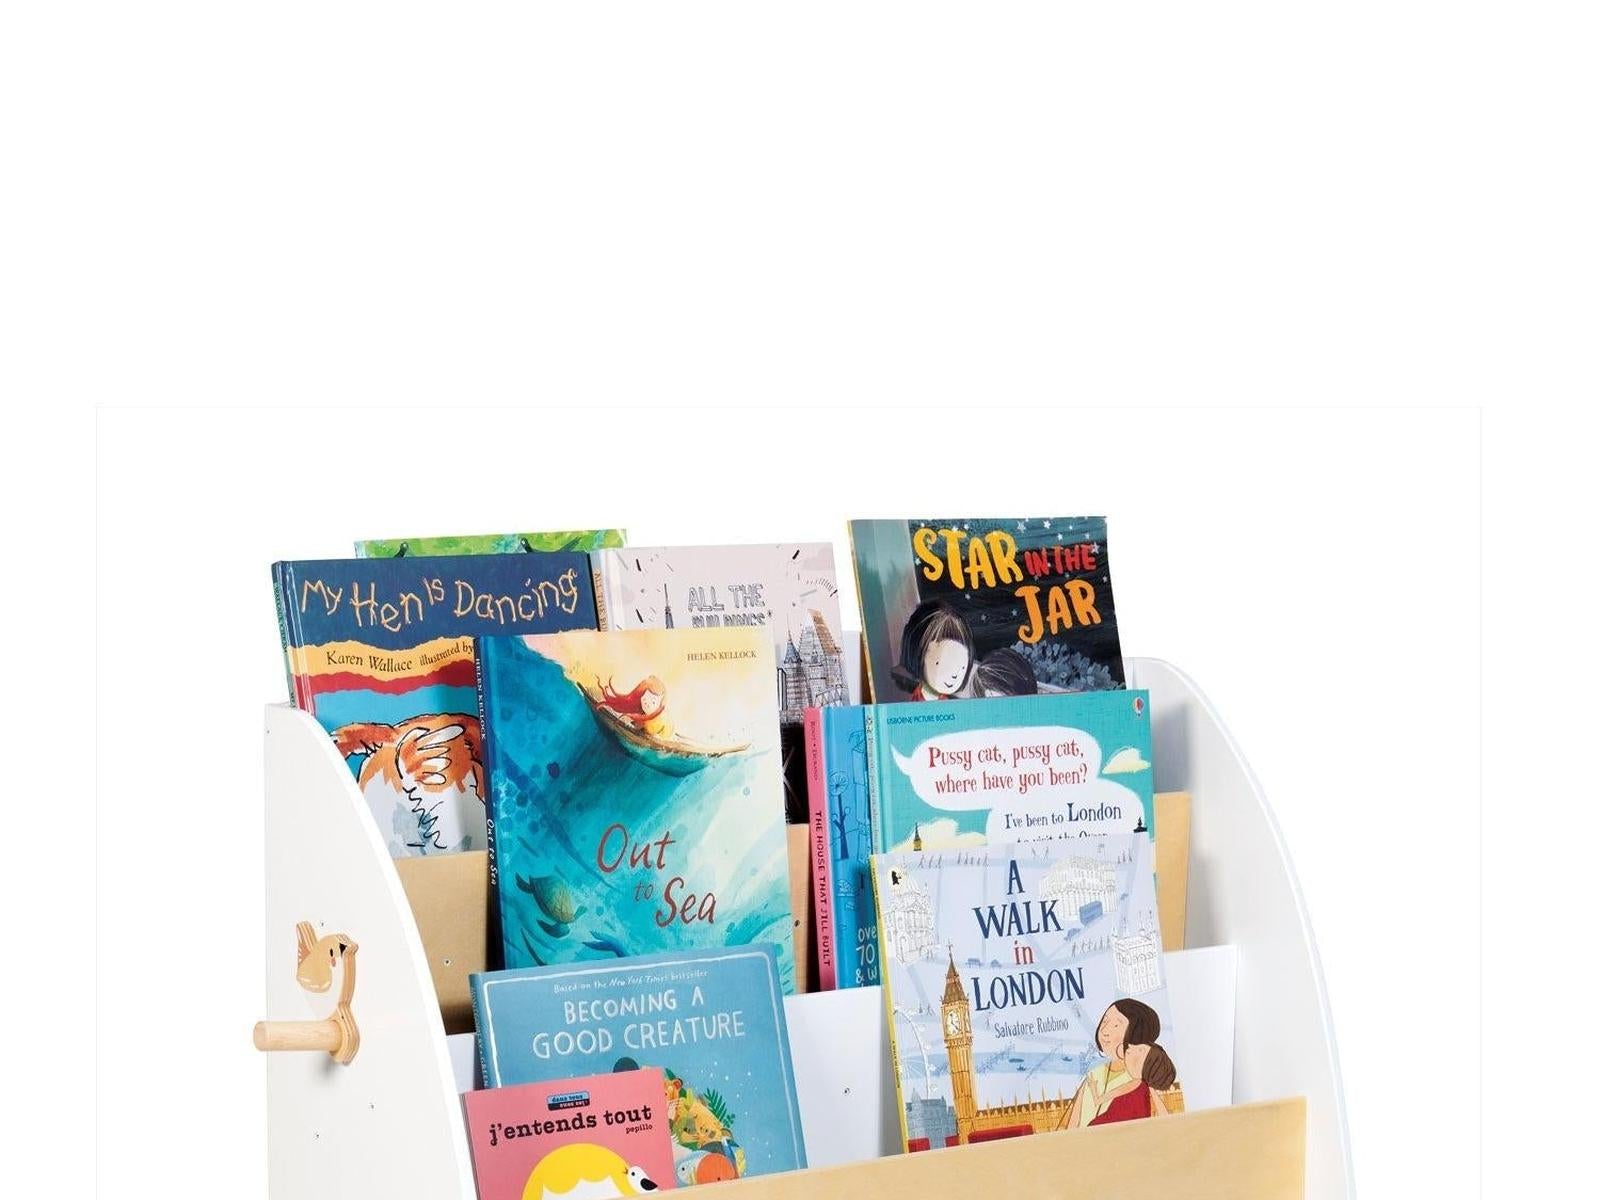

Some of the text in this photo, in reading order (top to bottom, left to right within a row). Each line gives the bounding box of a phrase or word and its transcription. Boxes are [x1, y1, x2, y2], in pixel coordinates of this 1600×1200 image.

[913, 527, 1097, 590] STAR IN THE
[301, 568, 579, 632] My Hen Is Dancing
[688, 583, 765, 613] ALL THE
[1014, 578, 1102, 644] JAR
[326, 641, 474, 673] Karen Wallace illustrated by
[687, 650, 757, 662] HELEN KELLOCK
[475, 658, 487, 741] HELEN KELLOCK
[928, 739, 1084, 771] Pussy cat, pussy cat,
[934, 763, 1088, 794] where have you been?
[1004, 802, 1122, 829] I've been to London
[596, 823, 676, 873] Out
[815, 810, 831, 967] THE HOUSE THAT JILL BUILT
[1006, 859, 1025, 896] A
[634, 877, 717, 928] to Sea
[972, 899, 1063, 940] WALK
[856, 943, 875, 966] 70
[1013, 940, 1034, 966] in
[553, 984, 578, 994] Based
[594, 980, 607, 989] the
[609, 979, 627, 988] New
[626, 976, 644, 985] York
[970, 967, 1086, 1012] LONDON
[563, 986, 705, 1026] BECOMING A
[532, 1010, 746, 1060] GOOD CREATURE
[994, 1020, 1035, 1039] Salvatore
[489, 1105, 652, 1147] j'entends tout
